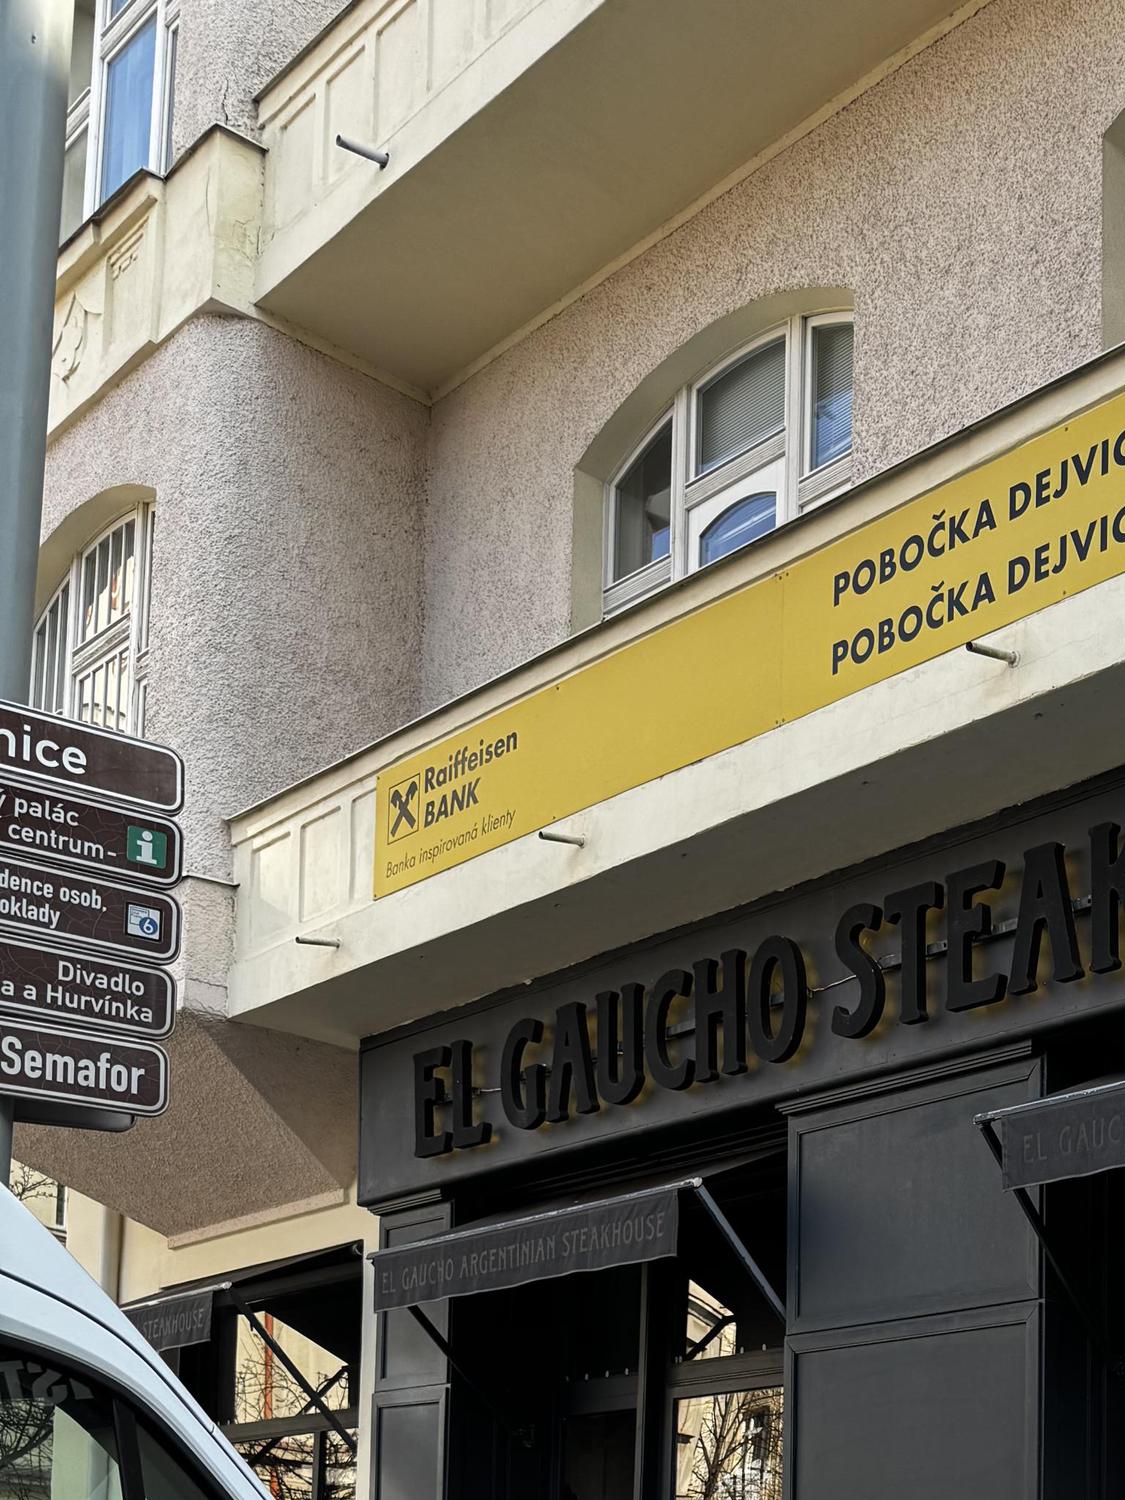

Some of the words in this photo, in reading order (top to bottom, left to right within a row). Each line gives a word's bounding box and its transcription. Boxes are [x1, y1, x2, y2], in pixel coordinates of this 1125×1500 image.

[832, 498, 996, 607] POBOČKA
[831, 571, 996, 675] POBOČKA
[424, 732, 518, 794] Raiffeisen
[14, 797, 79, 827] palác
[424, 777, 481, 828] BANK
[386, 852, 416, 878] Banka
[419, 822, 477, 863] inspirovaná
[481, 809, 516, 836] klienty
[59, 886, 107, 912] osob,
[23, 984, 37, 1001] a
[47, 984, 153, 1023] Hurvínka
[58, 961, 145, 996] Divadlo
[1, 1036, 145, 1095] Semafor
[413, 1038, 494, 1159] EL
[500, 934, 808, 1131] GAUCHO
[1023, 1134, 1049, 1165] EL
[382, 1271, 396, 1294] EL
[401, 1259, 454, 1290] GAUCHO
[460, 1236, 556, 1280] ARGENTINIAN
[562, 1211, 666, 1257] STEAKHOUSE
[143, 1308, 204, 1340] STEAKHOUSE
